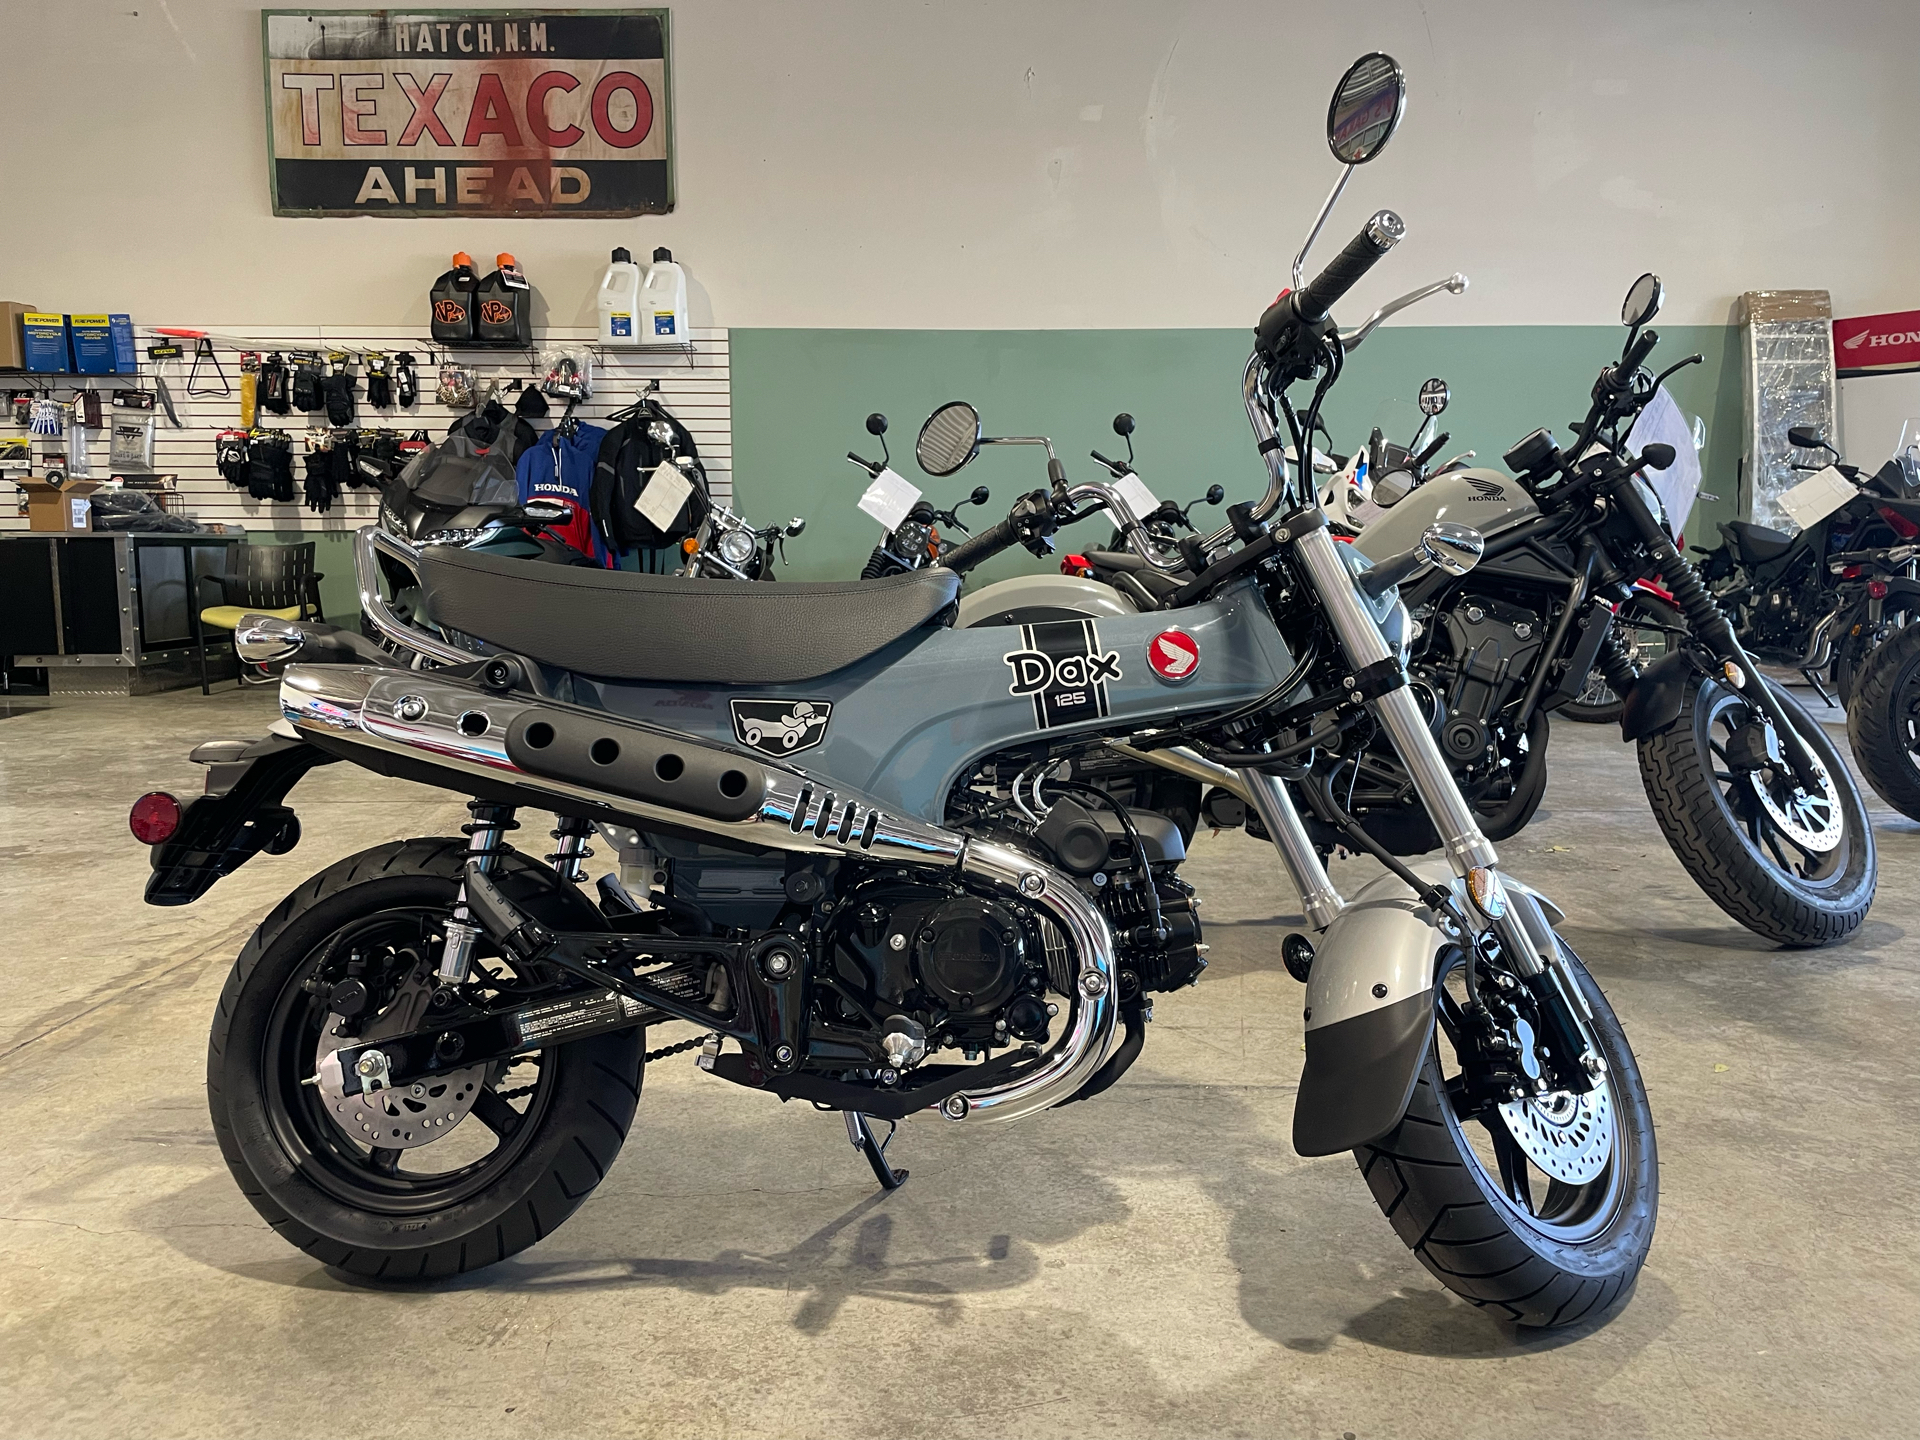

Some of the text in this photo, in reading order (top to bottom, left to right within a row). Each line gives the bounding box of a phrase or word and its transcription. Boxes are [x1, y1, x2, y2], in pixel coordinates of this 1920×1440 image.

[282, 70, 654, 148] TEXACO
[355, 166, 591, 204] AHEAD
[534, 483, 579, 497] HONDA
[1003, 649, 1123, 697] Dax
[1054, 691, 1087, 707] 125
